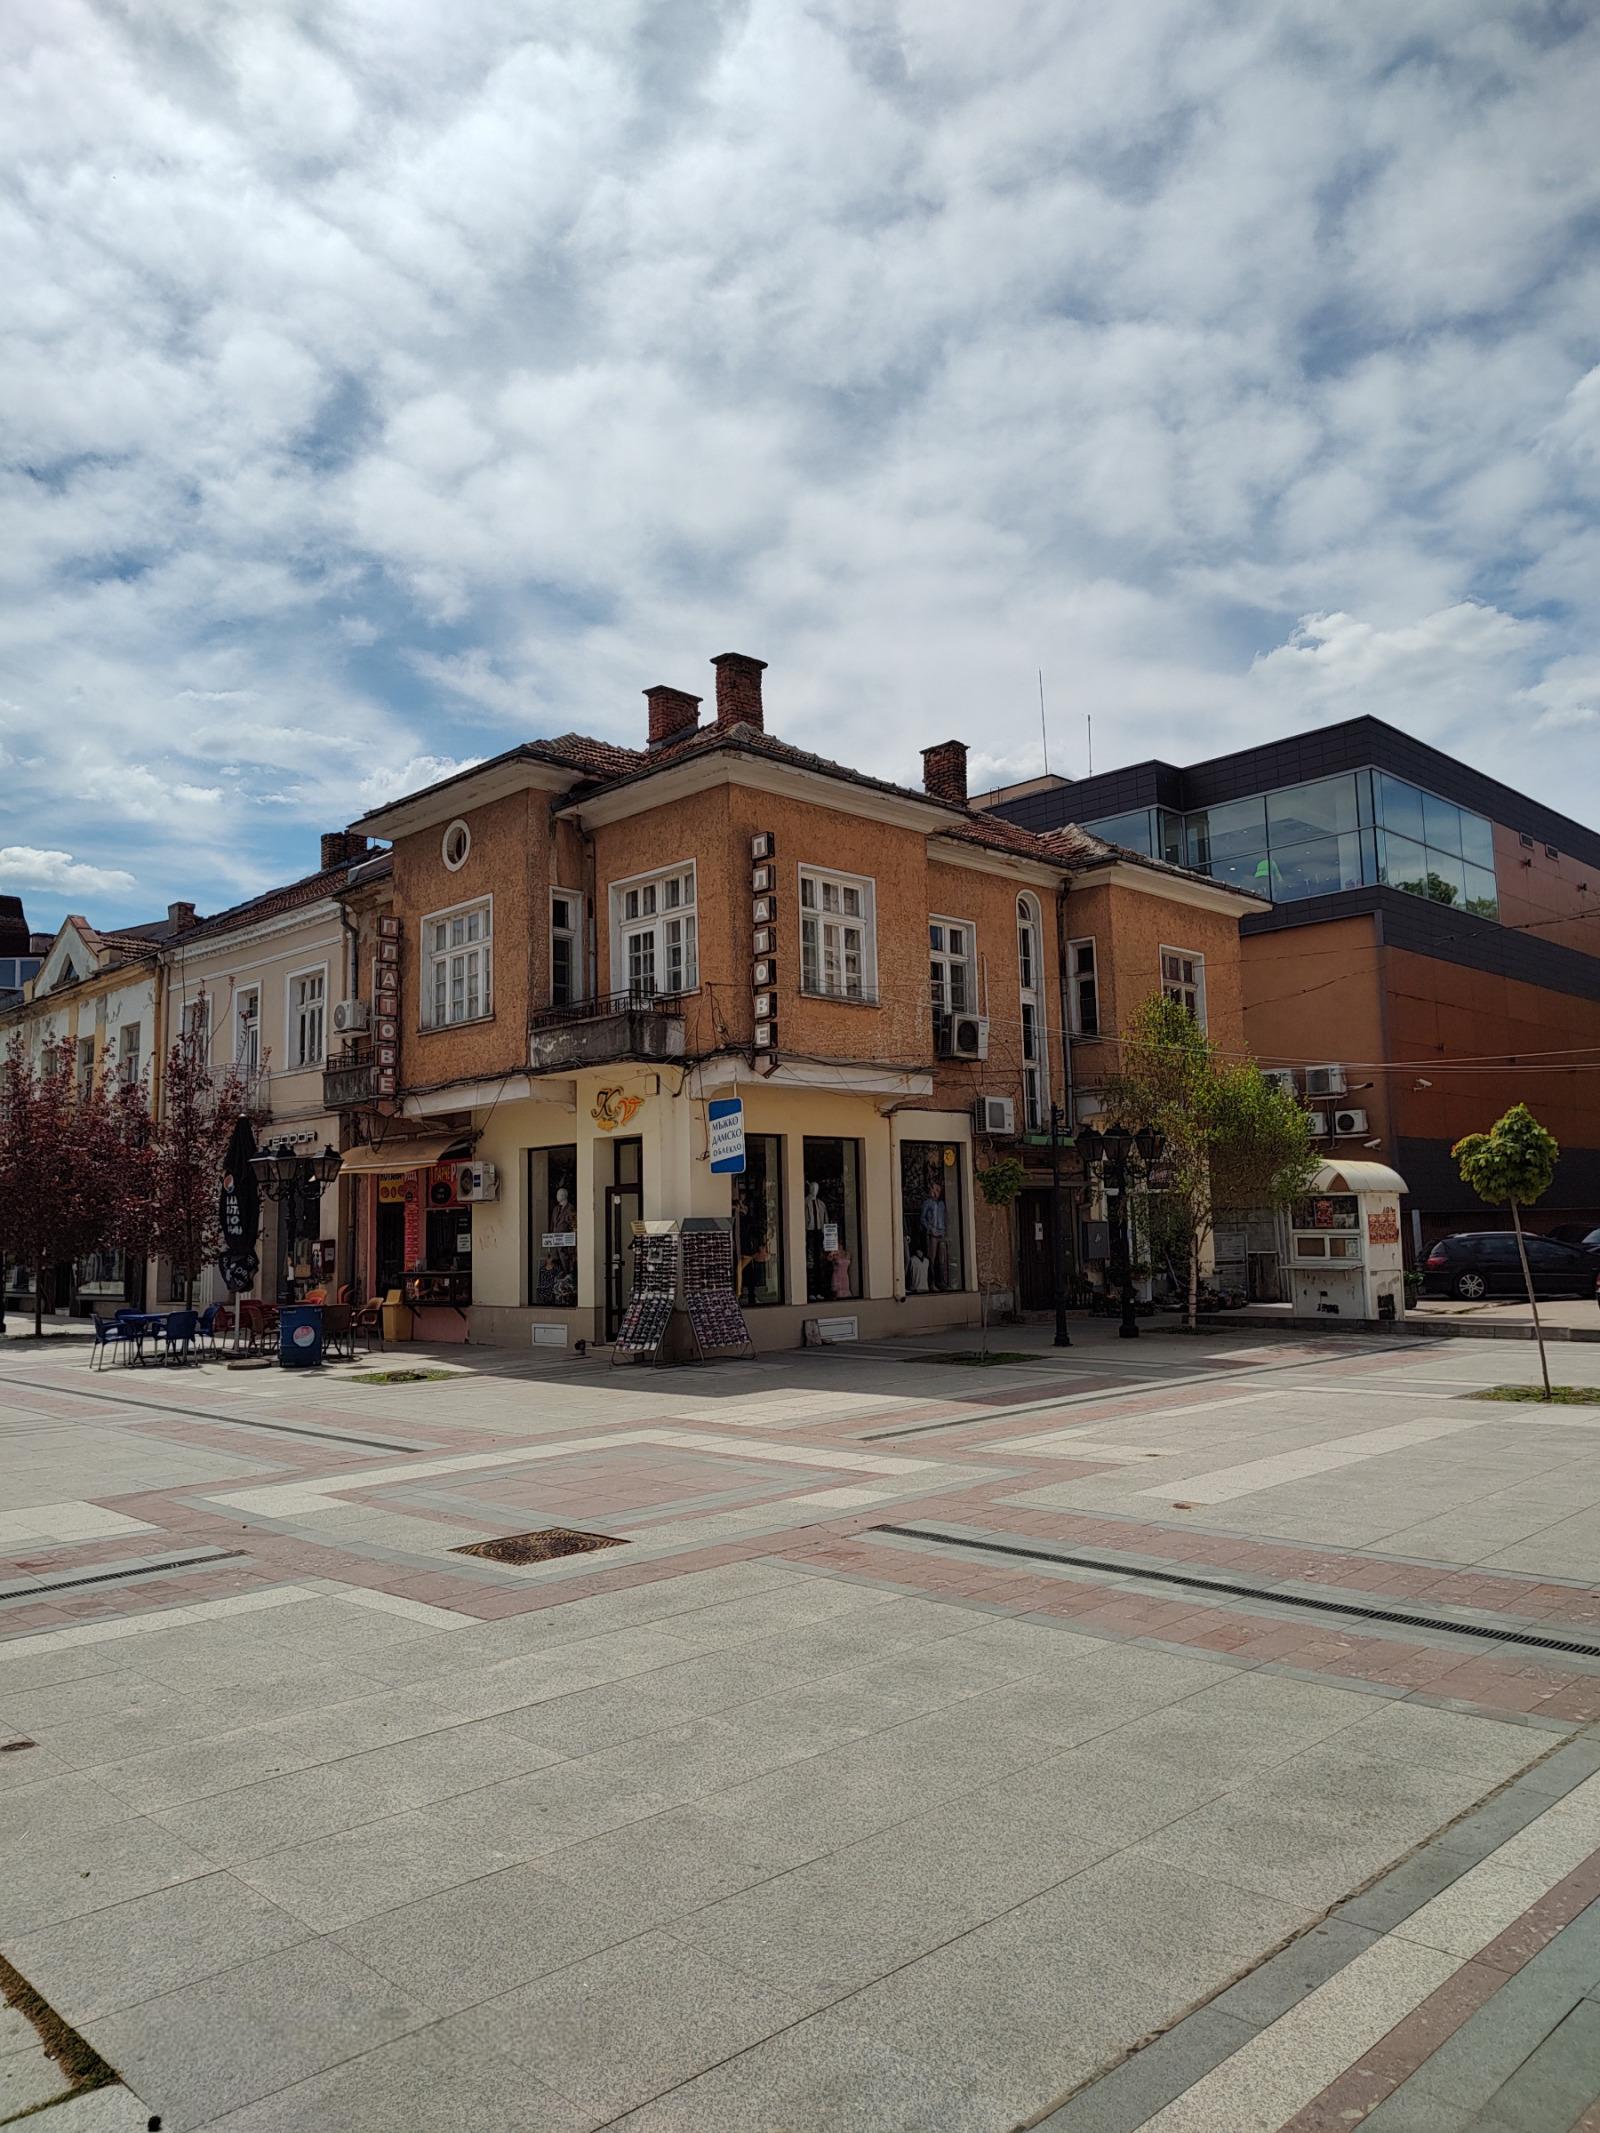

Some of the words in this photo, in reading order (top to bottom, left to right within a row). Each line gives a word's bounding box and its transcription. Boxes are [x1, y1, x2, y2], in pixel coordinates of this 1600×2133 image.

[752, 837, 768, 1045] ПЛАТОВЕ
[380, 919, 397, 1091] ПЛАТОВЕ
[712, 1116, 739, 1131] МЪЖКО
[712, 1128, 742, 1147] ДАМСКО
[712, 1143, 742, 1157] ОБЛЕКЛО
